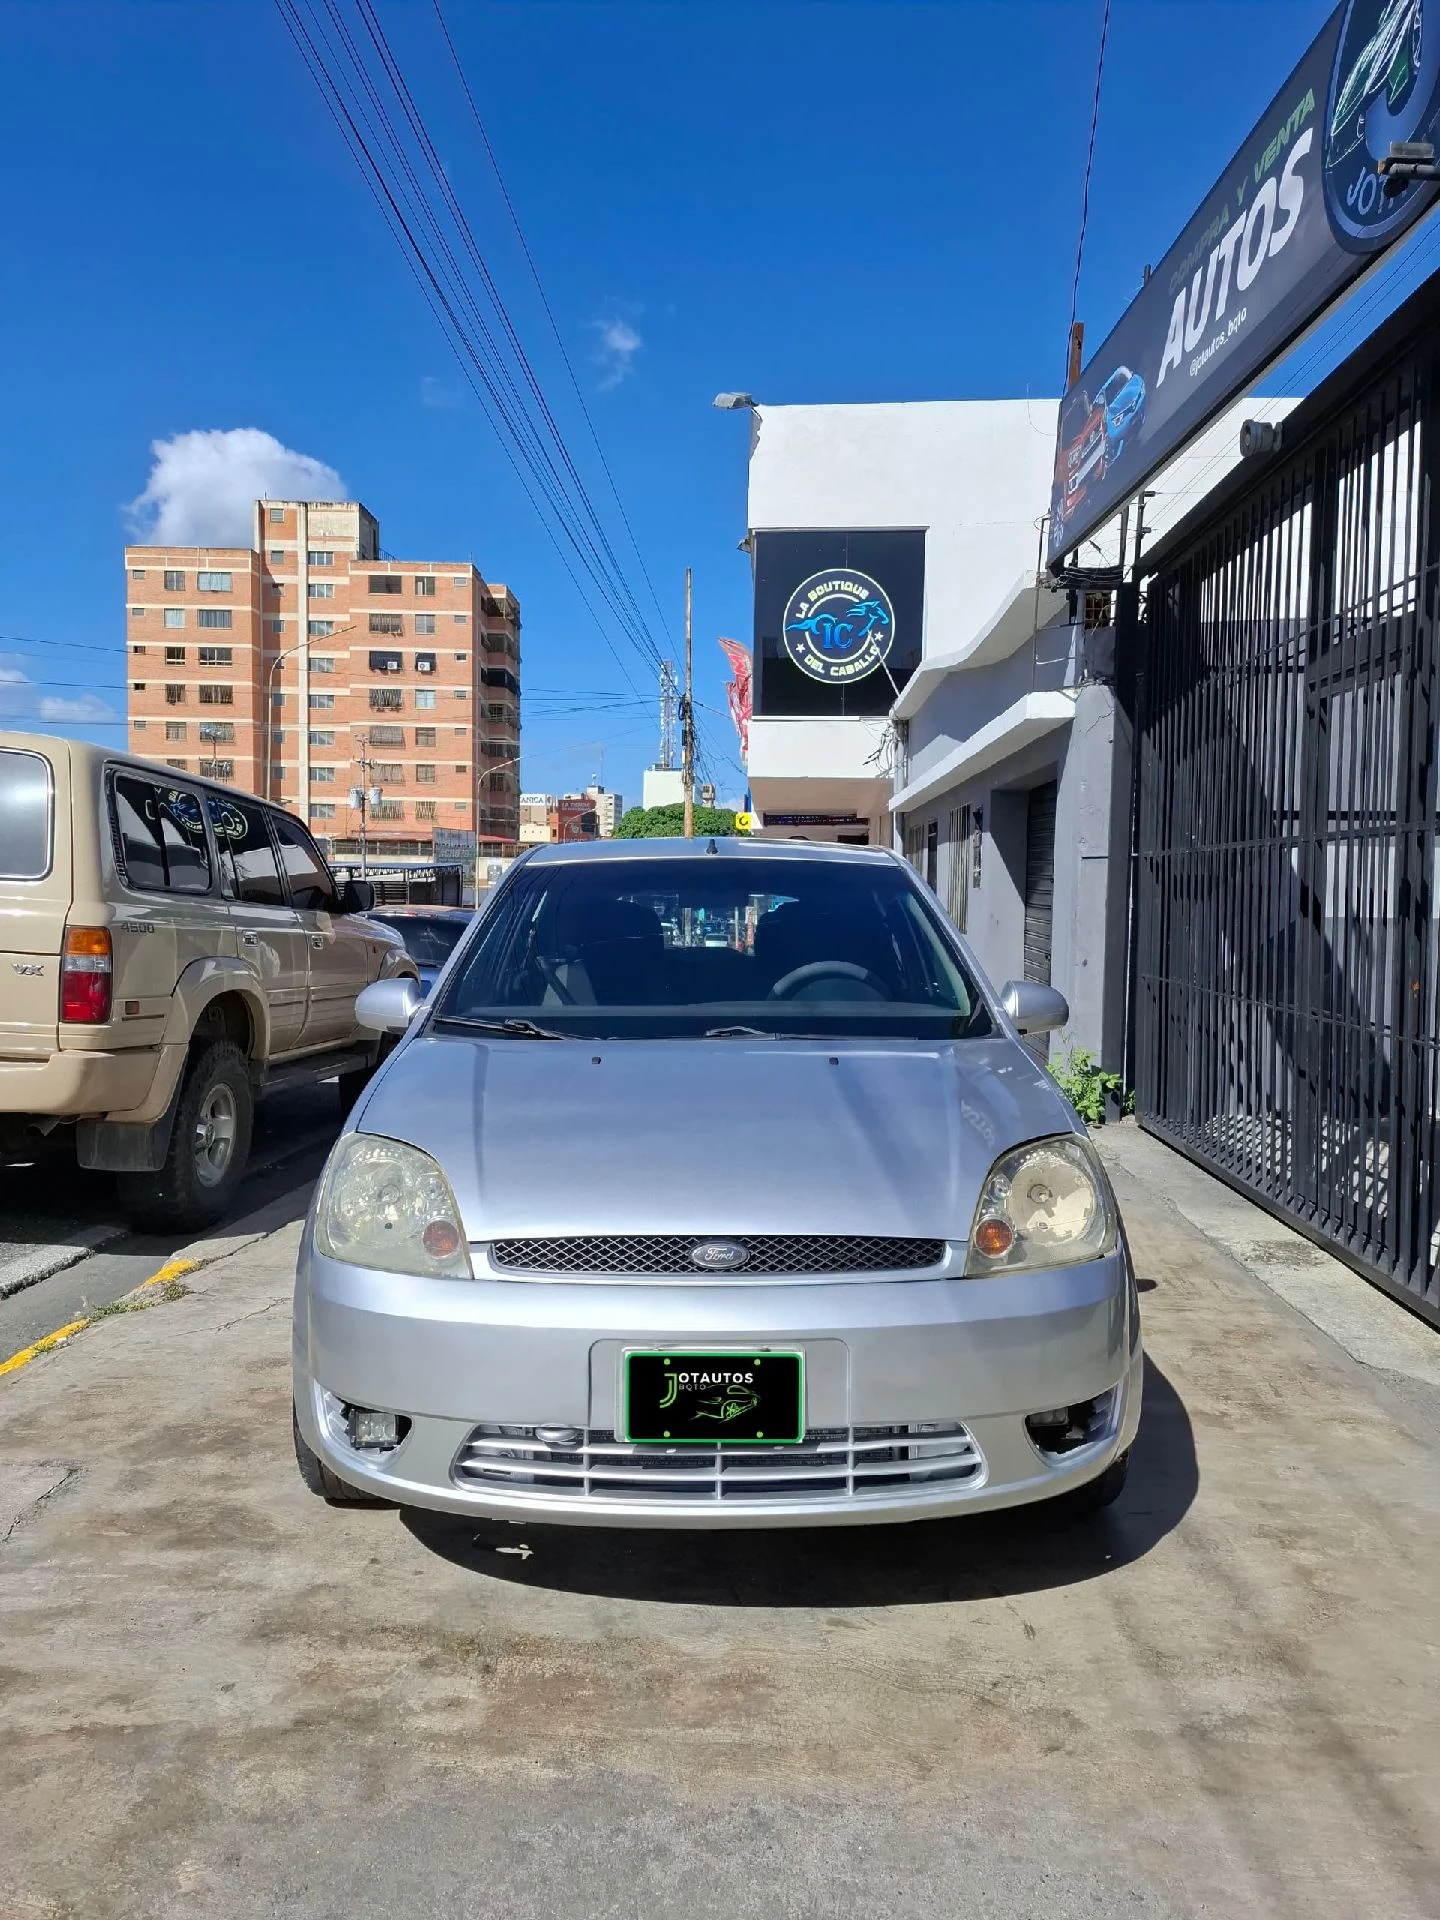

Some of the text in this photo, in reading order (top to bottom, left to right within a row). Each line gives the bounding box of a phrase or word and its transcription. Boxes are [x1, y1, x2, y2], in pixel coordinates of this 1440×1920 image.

[1236, 175, 1248, 206] Y
[1254, 88, 1315, 183] VENTA
[1156, 127, 1313, 387] AUTOS
[795, 580, 870, 619] LA BOUTIQUE
[804, 645, 880, 676] DEL CABALLO
[120, 922, 155, 934] 4500
[704, 1247, 734, 1261] Ford
